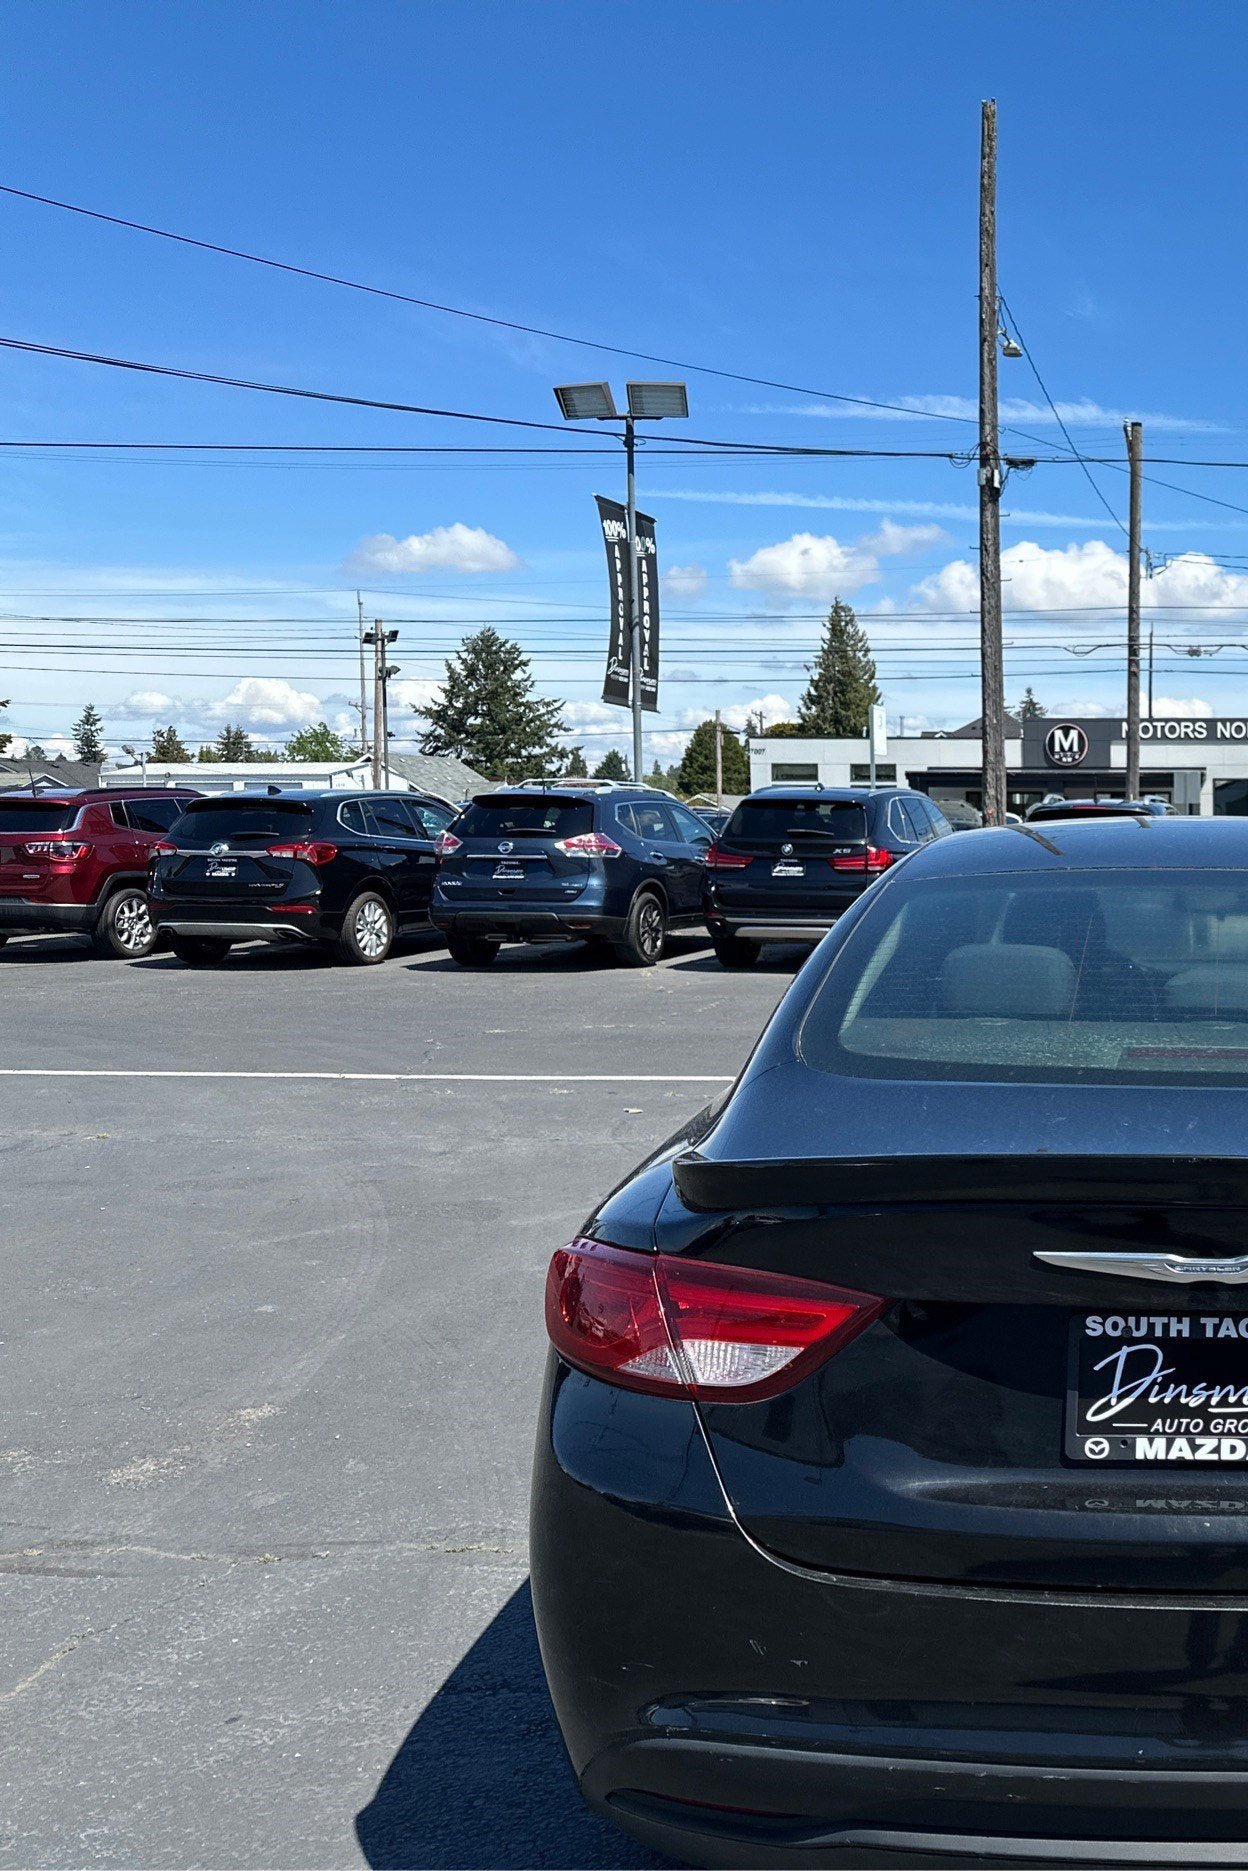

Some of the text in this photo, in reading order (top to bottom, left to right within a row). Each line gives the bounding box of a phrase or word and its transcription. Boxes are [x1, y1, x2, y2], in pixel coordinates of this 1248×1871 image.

[603, 519, 626, 539] 100%
[635, 535, 655, 554] 00%
[614, 544, 625, 661] APPROVAL
[641, 559, 651, 671] APPROVAL
[1054, 729, 1079, 752] M
[1085, 1315, 1190, 1337] SOUTH
[1150, 1418, 1204, 1433] AUTO
